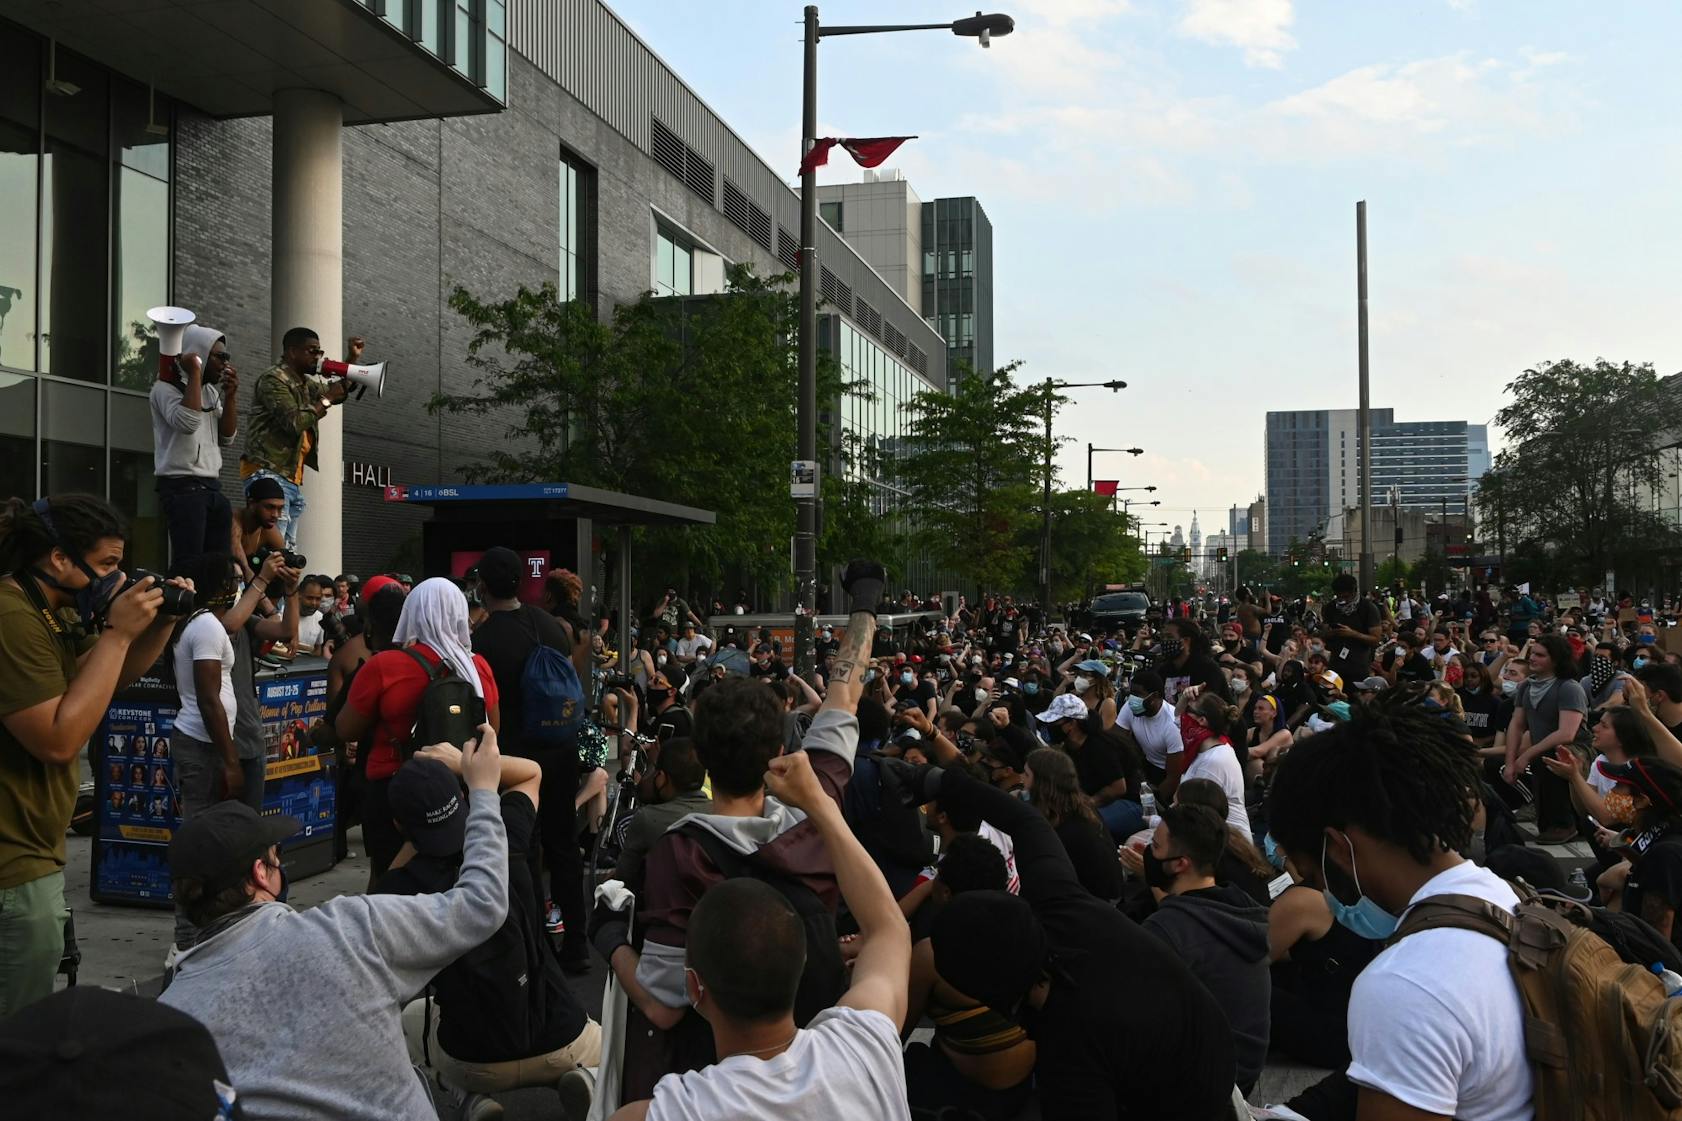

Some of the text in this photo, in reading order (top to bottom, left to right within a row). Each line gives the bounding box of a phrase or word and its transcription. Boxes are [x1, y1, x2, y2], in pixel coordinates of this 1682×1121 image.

[352, 462, 395, 488] HALL
[42, 608, 63, 633] Nikon
[267, 686, 285, 698] AUGUST
[285, 684, 299, 696] 23-25
[118, 709, 152, 717] KEYSTONE
[260, 704, 281, 720] Home
[281, 701, 290, 719] of
[290, 701, 303, 717] Pop
[426, 809, 441, 818] MAKE
